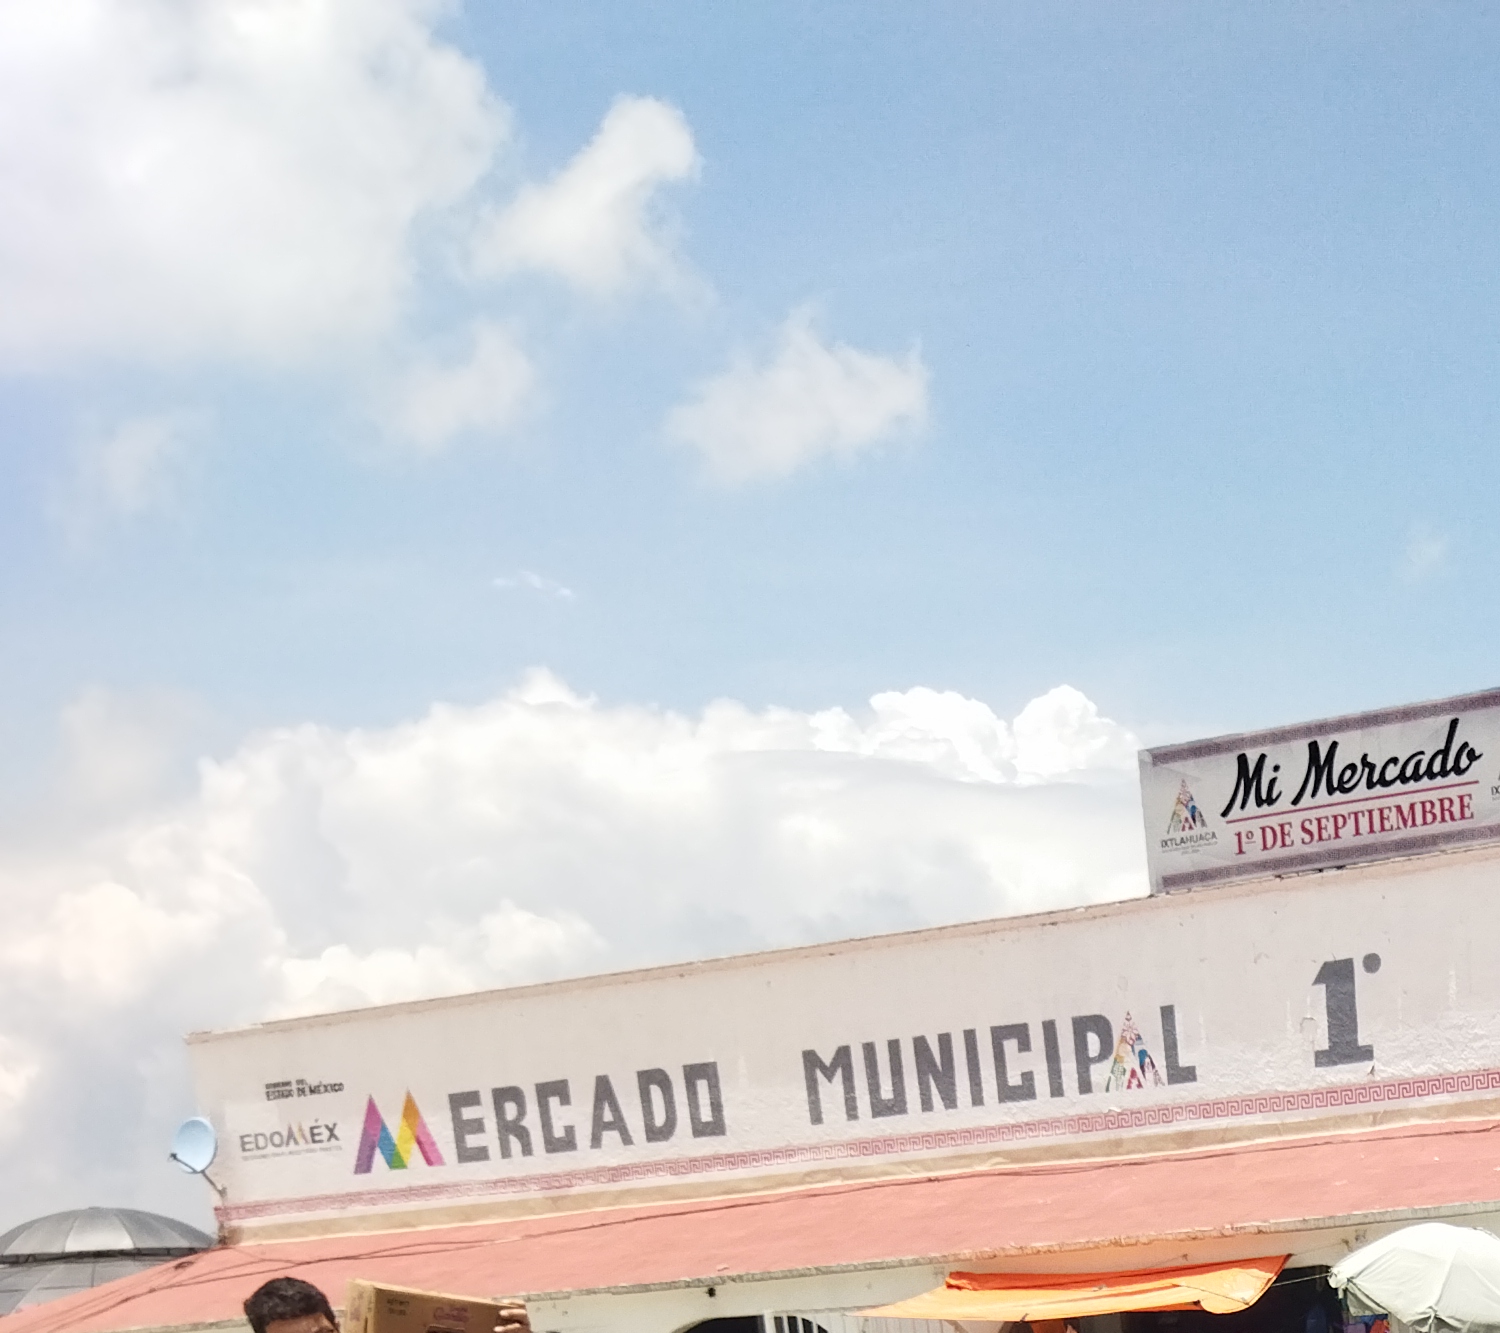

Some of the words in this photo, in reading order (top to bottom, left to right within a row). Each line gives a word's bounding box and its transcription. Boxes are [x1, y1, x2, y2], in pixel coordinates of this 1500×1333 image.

[1220, 752, 1282, 817] Mi
[1291, 717, 1484, 806] Mercado
[1260, 821, 1295, 851] DE
[1300, 793, 1475, 845] SEPTIEMBRE
[354, 1061, 727, 1175] MERCADO
[801, 1004, 1198, 1126] MUNICIPAL
